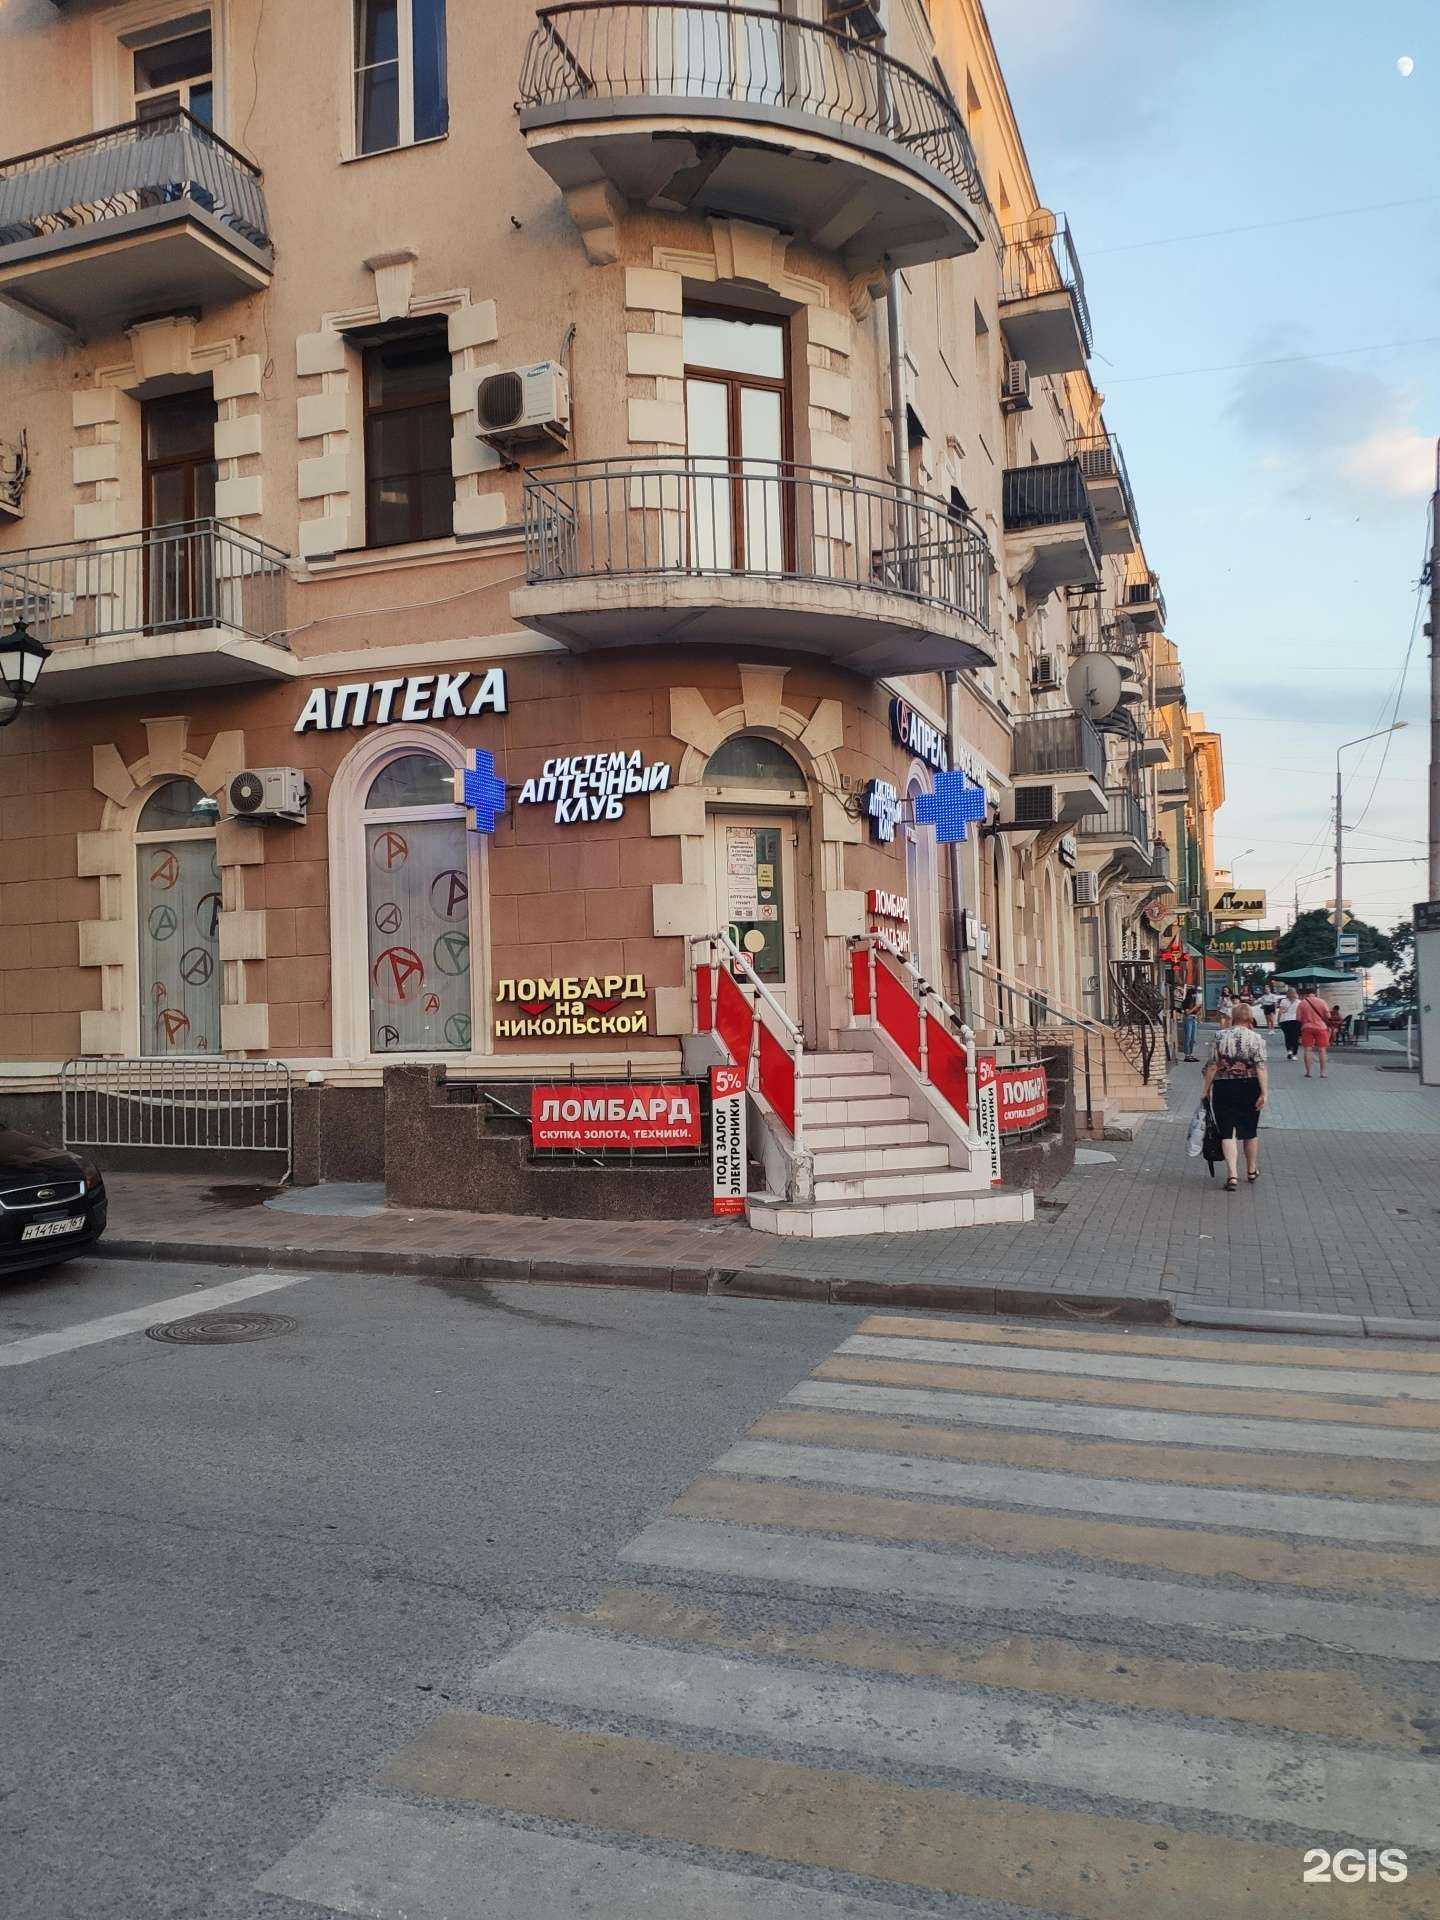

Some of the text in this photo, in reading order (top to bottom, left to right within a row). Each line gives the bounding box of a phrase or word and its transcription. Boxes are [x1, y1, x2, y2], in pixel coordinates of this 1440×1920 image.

[294, 668, 507, 732] АПТЕКА
[543, 749, 643, 777] СИСТЕМА
[518, 761, 672, 803] АПТЕЧНЫЙ
[554, 794, 625, 823] КЛУБ
[496, 974, 647, 1002] ЛОМБАРД
[555, 1000, 585, 1016] на
[495, 1010, 647, 1037] НИКОЛЬСКОЙ
[715, 1071, 742, 1092] 5%
[540, 1098, 692, 1125] ЛОМБАРД
[540, 1128, 692, 1141] СКУПКА ЗОЛОТА, ТЕХНИКИ.
[716, 1108, 728, 1185] ПОД ЗАЛОГ
[729, 1098, 741, 1195] ЭЛЕКТРОНИКИ
[988, 1087, 998, 1178] ЭЛЕКТРОНИКИ
